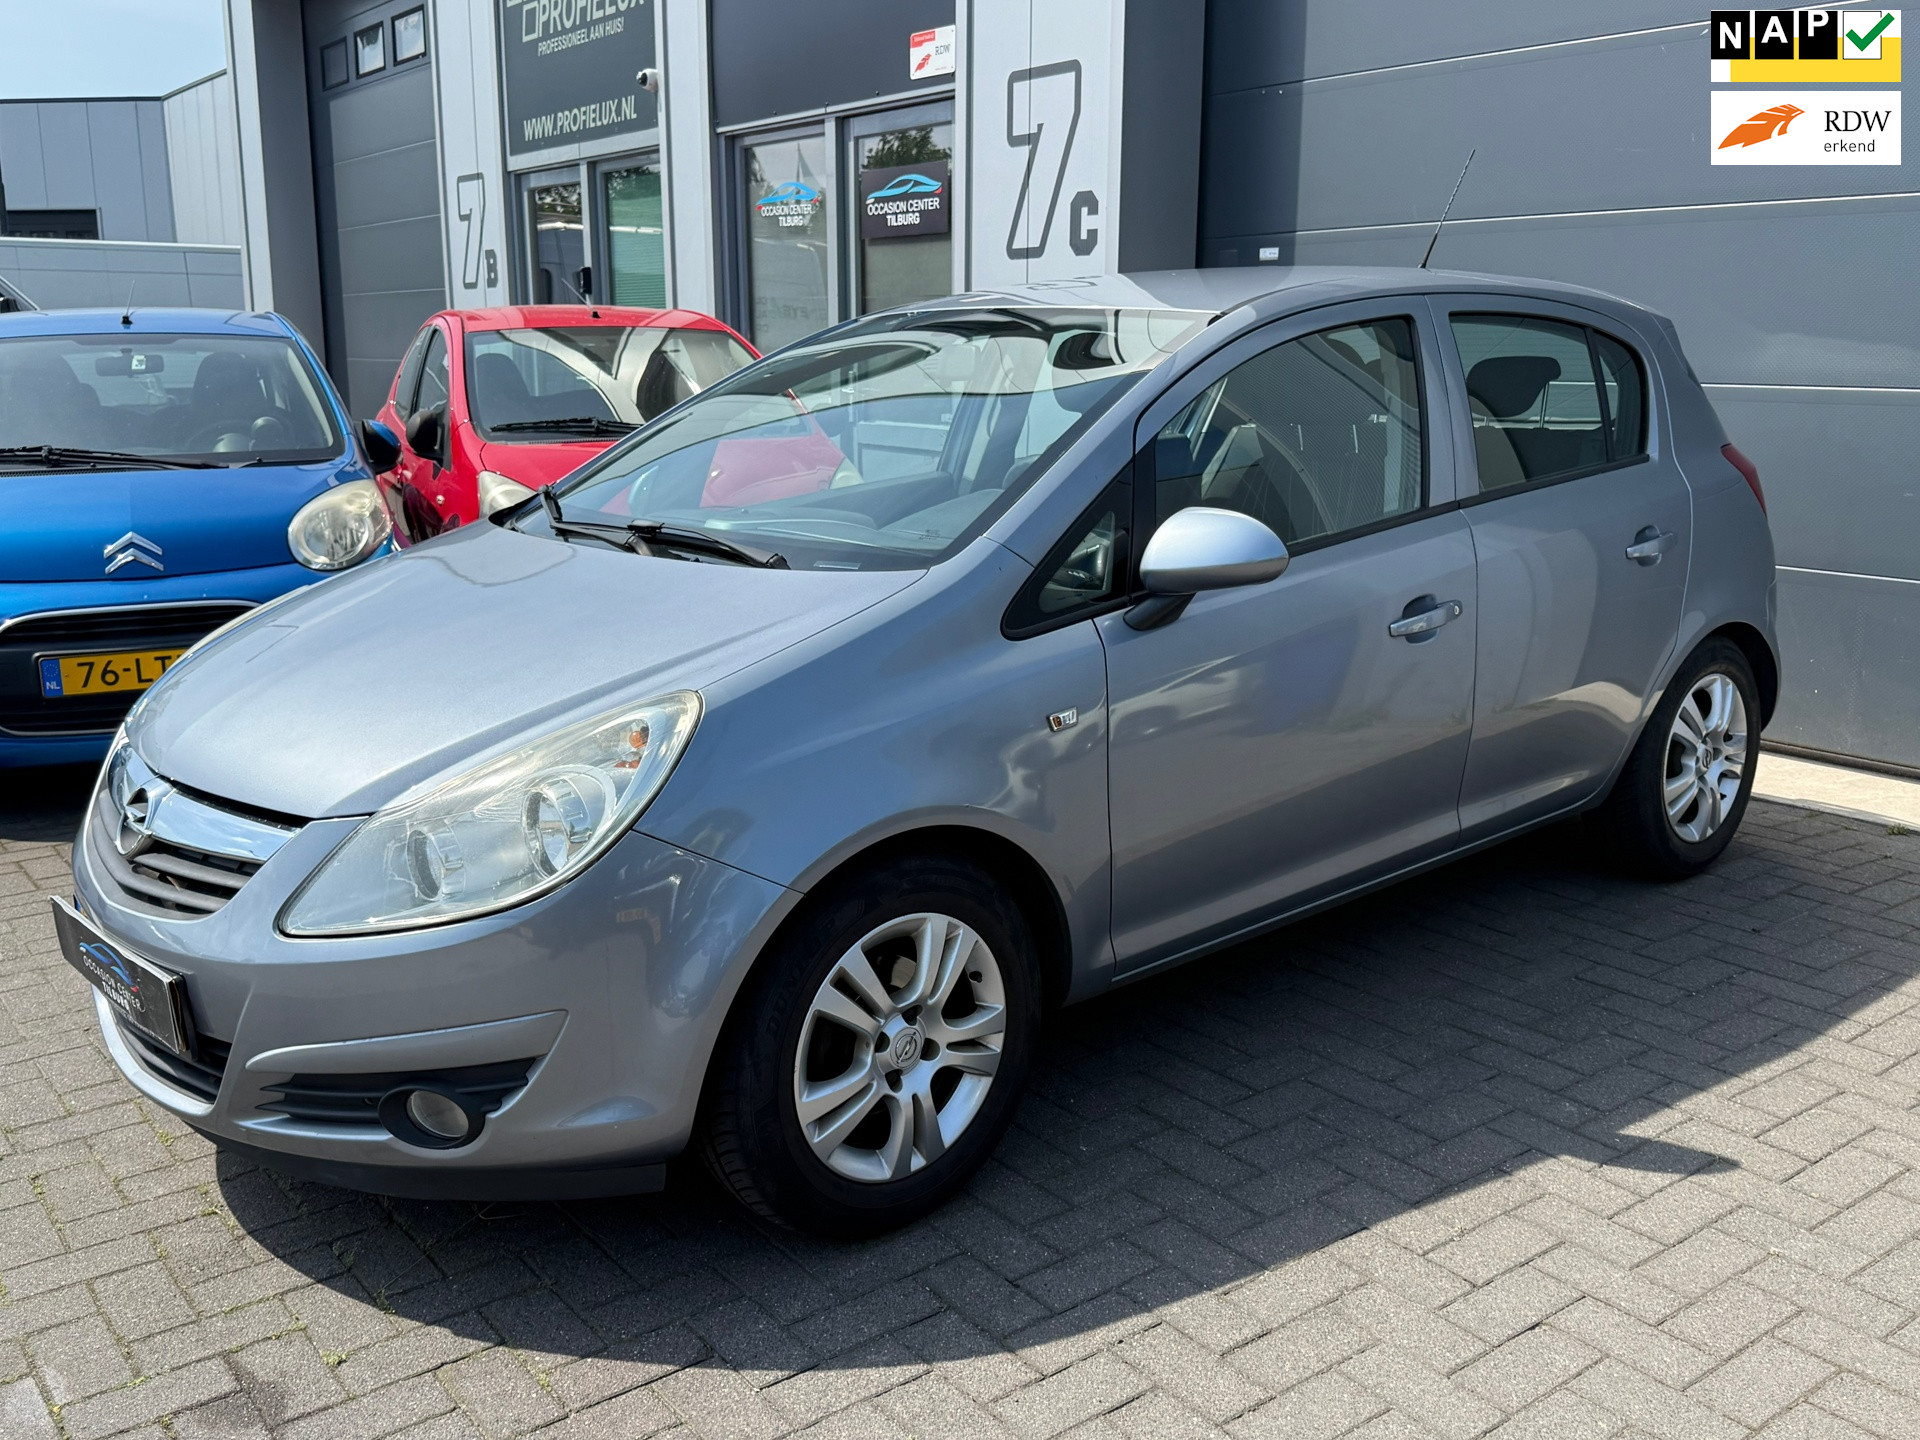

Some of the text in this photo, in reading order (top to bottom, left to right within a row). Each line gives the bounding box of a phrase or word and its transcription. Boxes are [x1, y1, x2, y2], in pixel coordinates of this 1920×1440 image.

[539, 0, 645, 38] PROFI
[538, 17, 624, 56] PROFESSIONEEL AAN HUIS!
[523, 95, 638, 141] WWW.PROFIELUX.NL
[760, 203, 812, 217] OCCASION CENTER
[867, 197, 940, 216] OCCASION CENTER
[778, 214, 804, 227] TILBURG
[886, 212, 920, 227] TILBURG
[77, 654, 184, 688] 76-LT
[46, 681, 61, 690] NL
